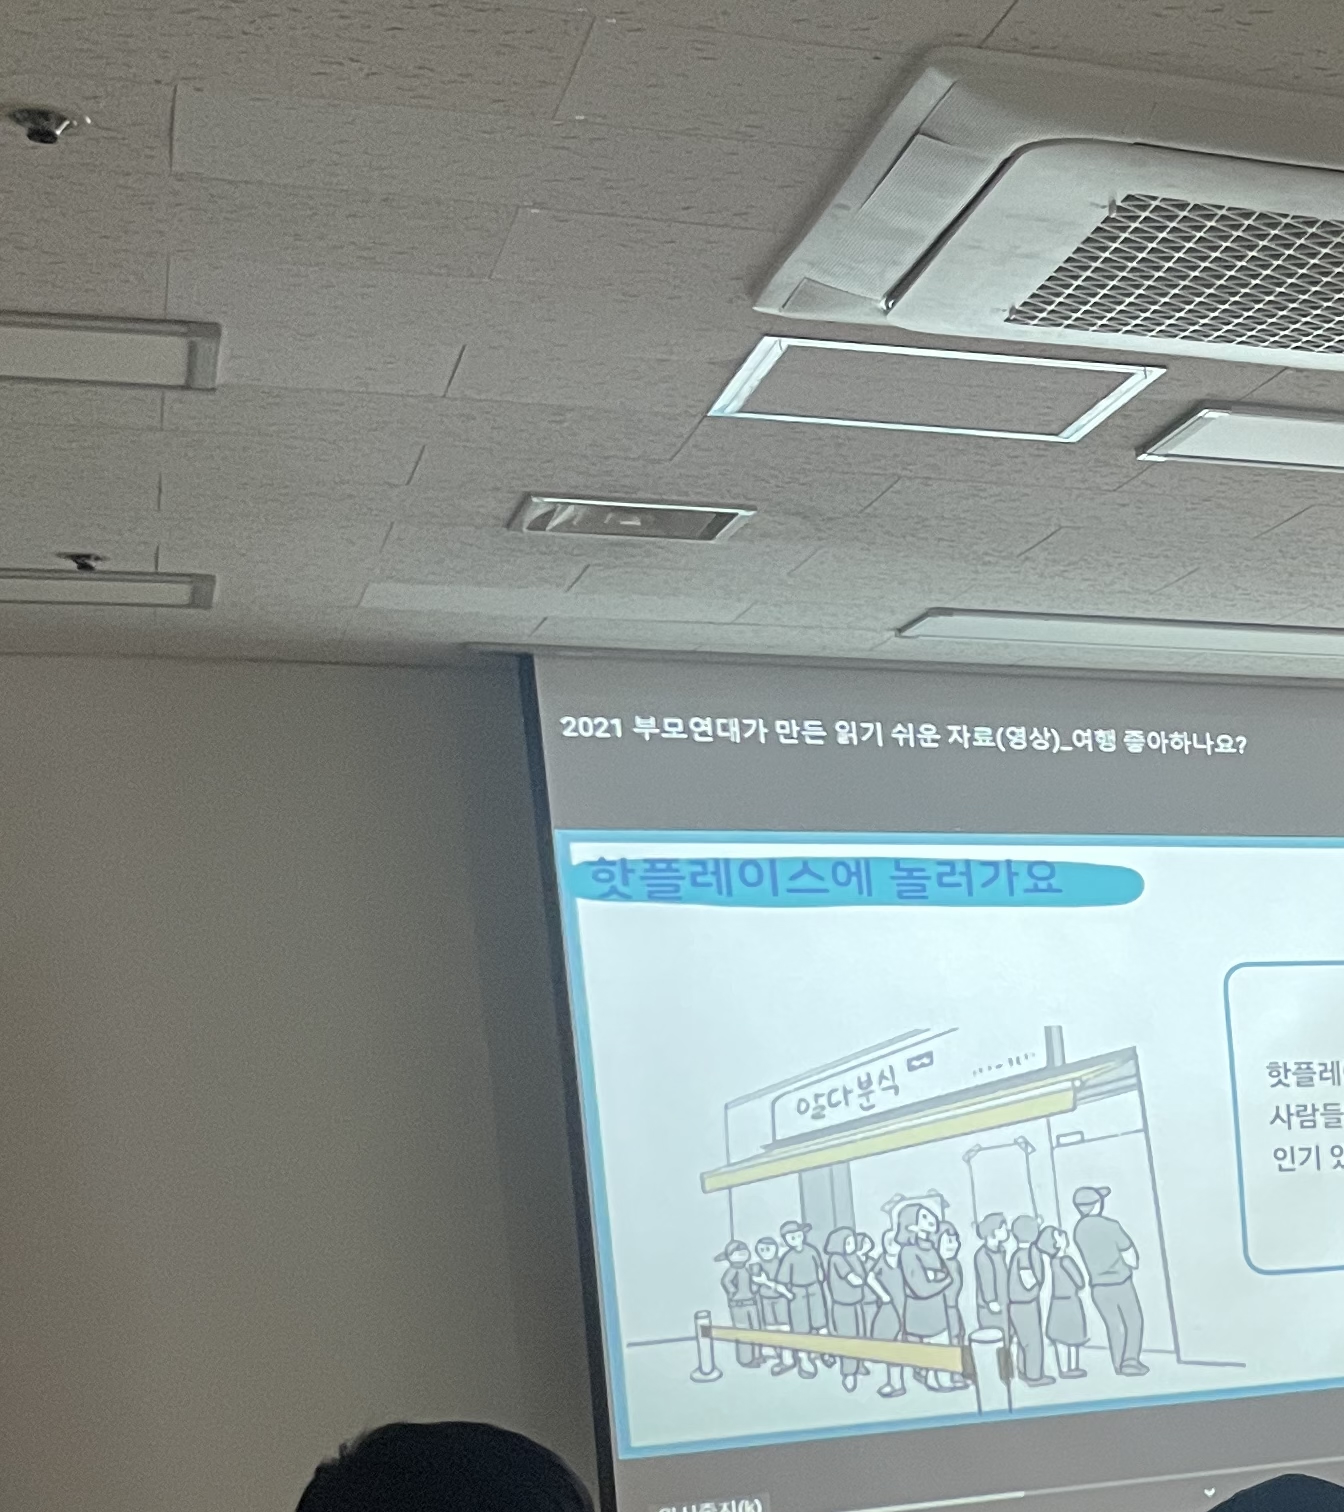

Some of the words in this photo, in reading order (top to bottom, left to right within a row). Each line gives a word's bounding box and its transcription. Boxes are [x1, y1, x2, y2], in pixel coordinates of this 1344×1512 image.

[559, 715, 624, 739] 2021
[632, 715, 768, 744] 부모연대가
[774, 719, 827, 745] 만든
[834, 721, 884, 747] 읽기
[891, 722, 941, 748] 쉬운
[947, 724, 1118, 753] 자료(영상)_여행
[1122, 729, 1248, 756] 좋아하나요?
[589, 856, 874, 901] 핫플레이스에
[888, 859, 1064, 901] 놀러가요
[795, 1063, 901, 1120] 알다분식
[1272, 1143, 1321, 1173] 인기
